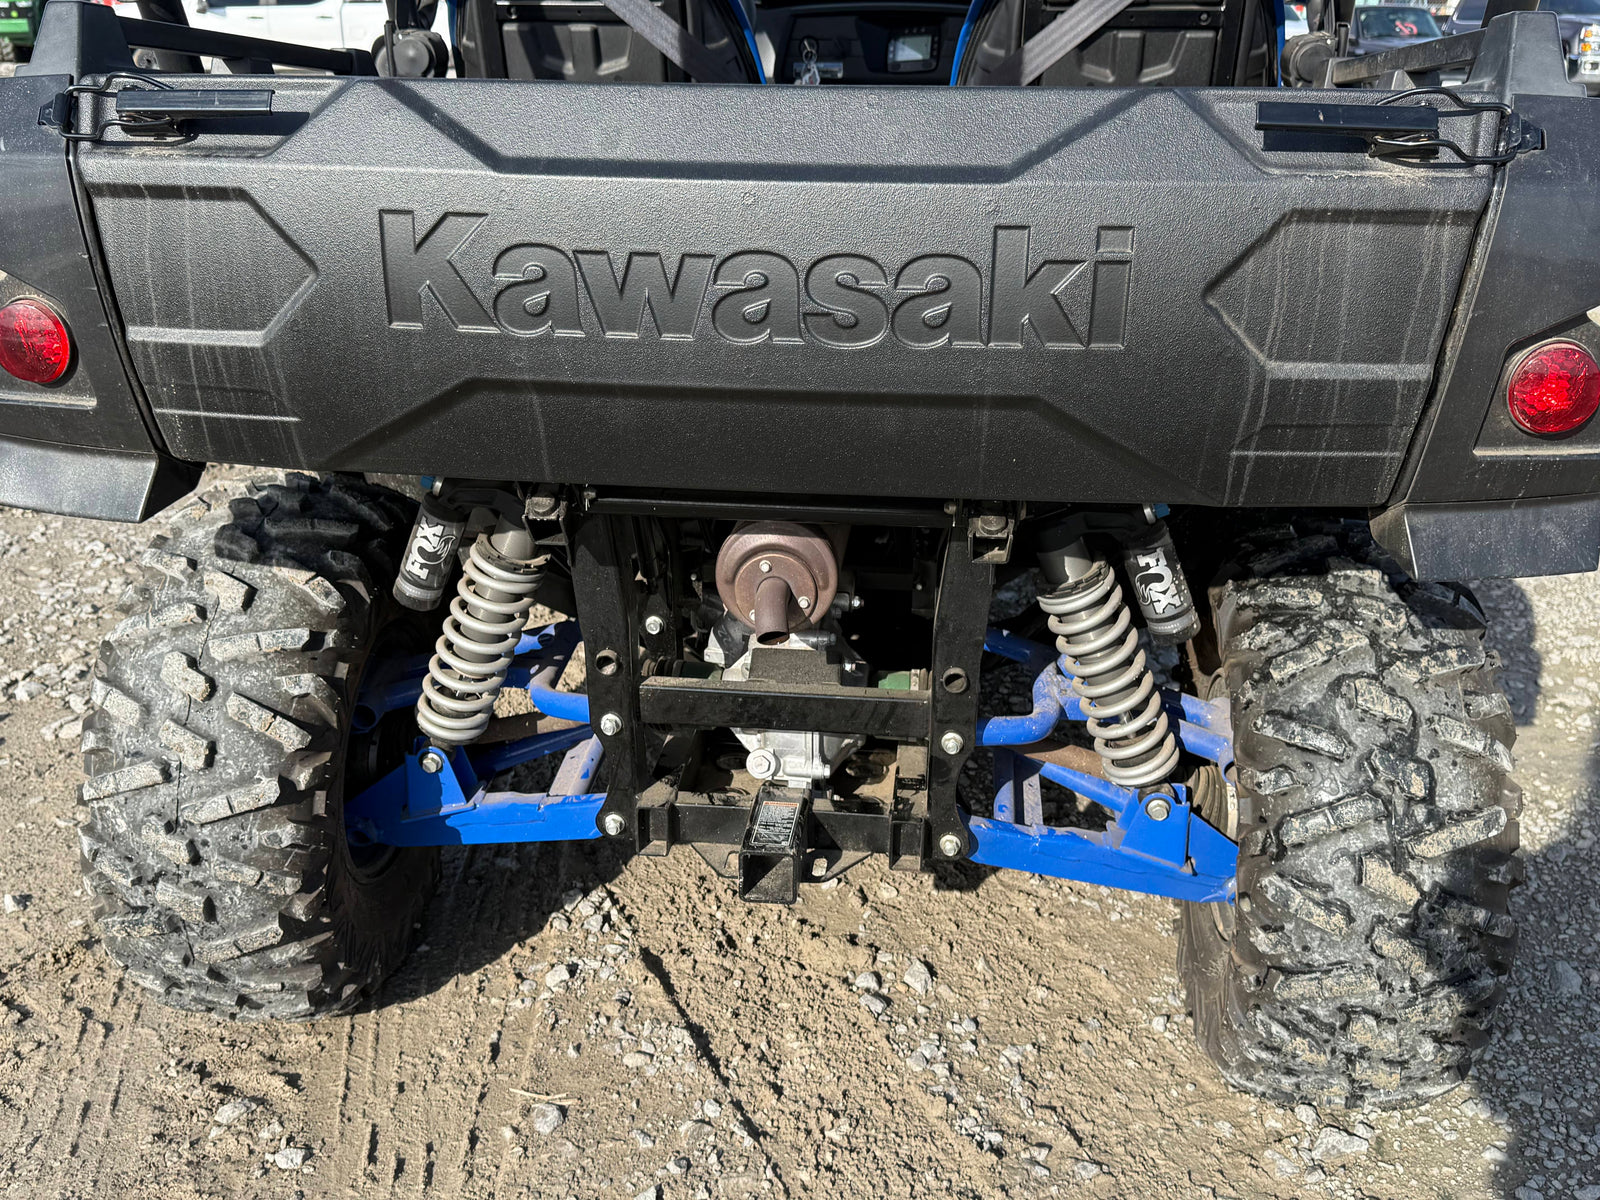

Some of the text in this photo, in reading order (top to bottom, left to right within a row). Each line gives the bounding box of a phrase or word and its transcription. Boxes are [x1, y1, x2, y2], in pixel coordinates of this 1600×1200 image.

[378, 208, 1136, 350] Kawasaki
[405, 515, 456, 580] FOX
[1135, 547, 1182, 614] FOX
